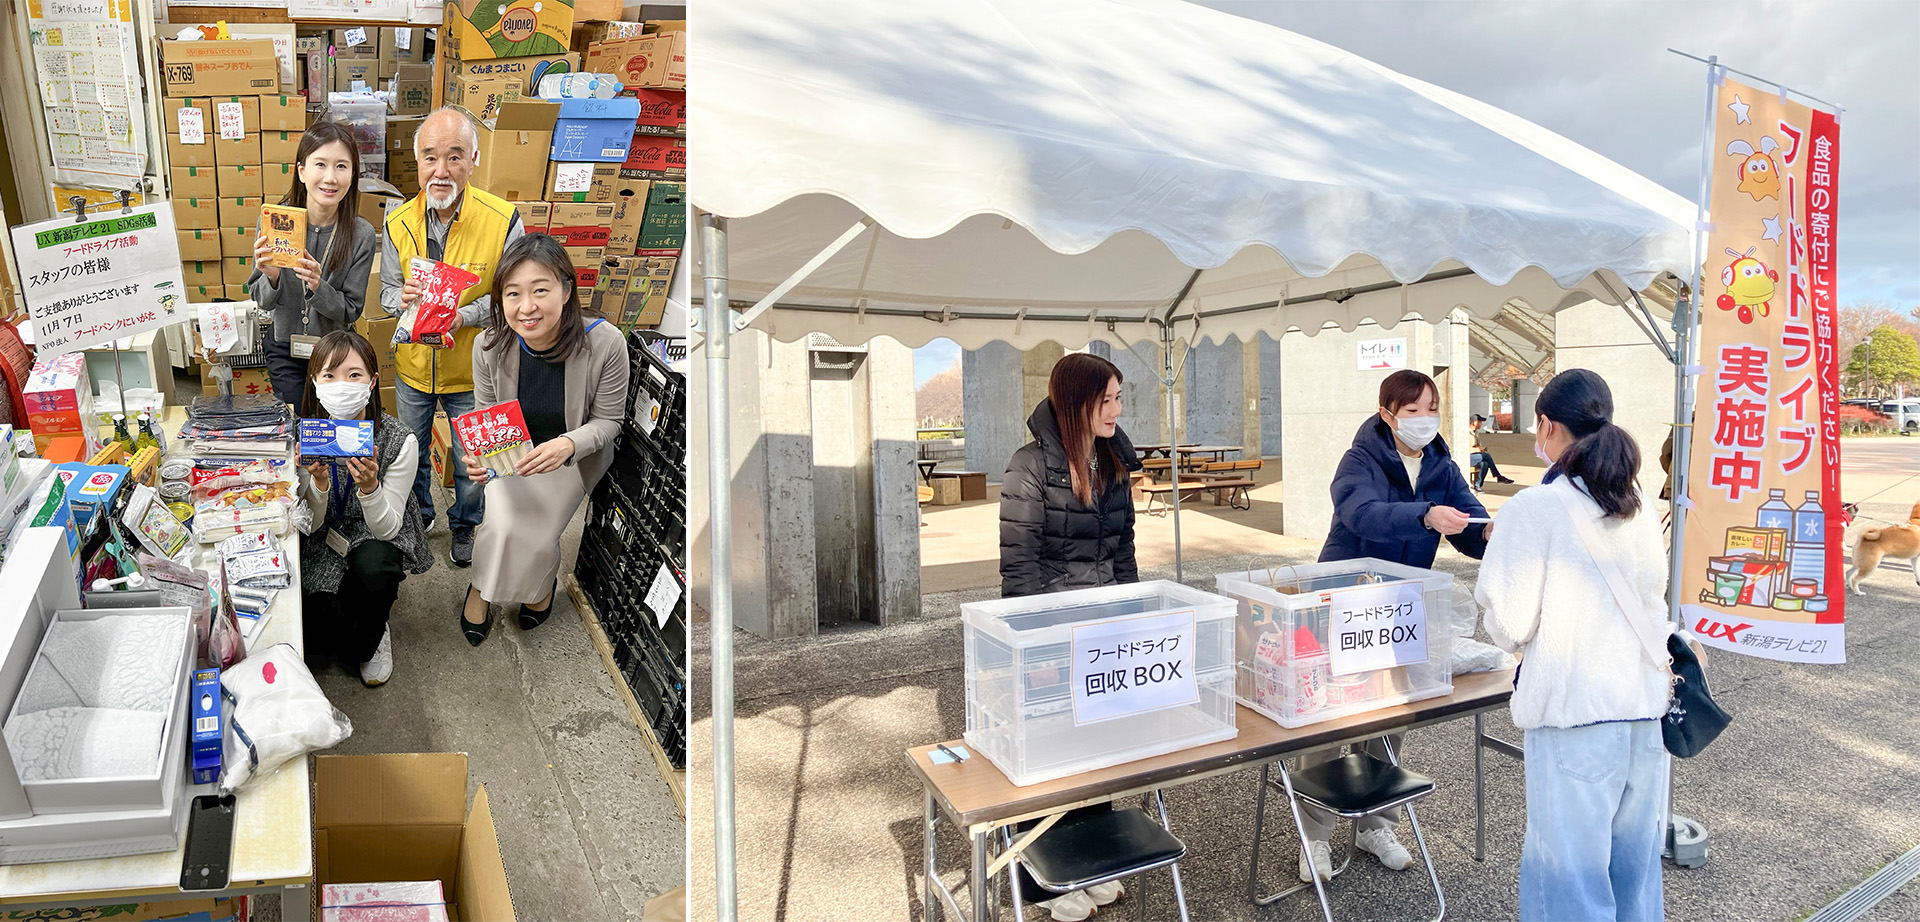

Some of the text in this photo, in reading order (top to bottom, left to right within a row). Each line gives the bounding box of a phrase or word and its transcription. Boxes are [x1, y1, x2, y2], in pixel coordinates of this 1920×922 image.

[167, 66, 194, 83] X-769
[469, 62, 526, 74] ぐんま つまごい
[559, 139, 584, 158] A4
[36, 214, 157, 246] UX 新潟テレビ 21 SDGs活動
[63, 236, 139, 259] フードドライブ活動
[29, 257, 111, 288] スタッフの皆様
[35, 283, 140, 319] ご支援ありがとうございます
[1778, 119, 1817, 473] フードドライブ
[1810, 135, 1839, 491] 食品の寄付にご協力ください!
[42, 311, 157, 351] NPO 法人 フードバンクにいがた
[1361, 343, 1387, 354] トイレ
[1710, 346, 1769, 500] 実施中
[465, 426, 523, 452] いっぽん
[1804, 518, 1819, 537] 水
[1343, 601, 1415, 624] フードドライブ
[1087, 634, 1182, 664] フードドライブ
[1340, 623, 1418, 651] 回収 BOX
[1740, 633, 1827, 654] 新潟テレビ21
[1085, 659, 1183, 697] 回収 BOX
